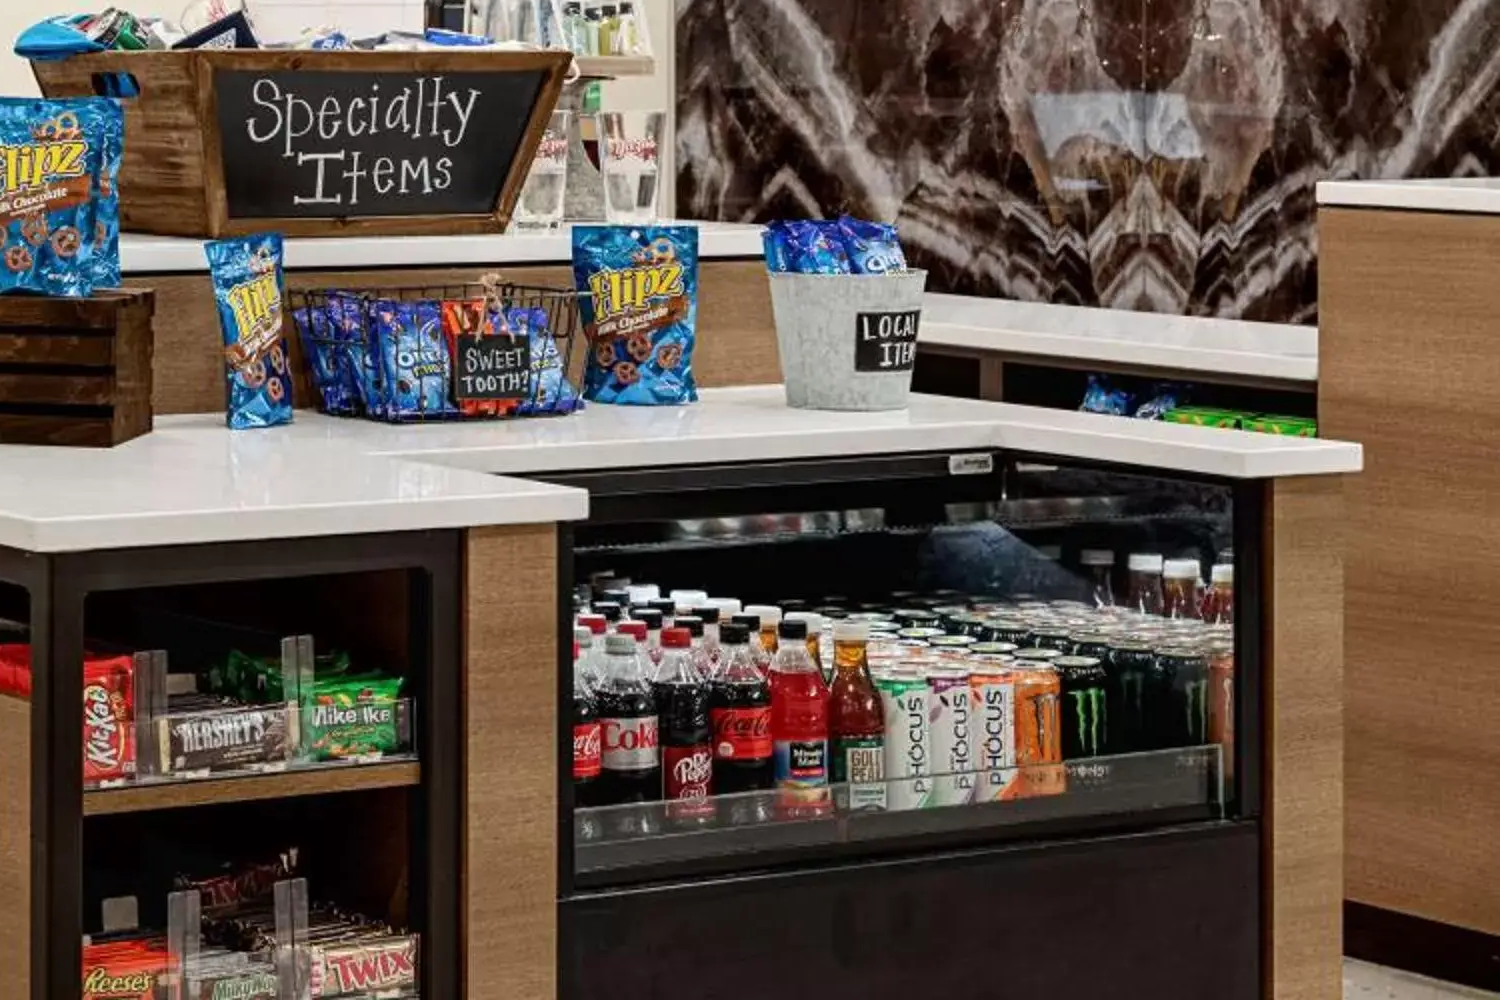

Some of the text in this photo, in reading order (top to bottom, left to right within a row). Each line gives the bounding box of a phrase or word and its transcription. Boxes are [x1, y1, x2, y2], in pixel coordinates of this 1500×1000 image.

[246, 75, 482, 157] Specialty
[465, 347, 525, 373] SWEET
[461, 370, 530, 394] TOOTH?
[84, 967, 152, 993] Reese's
